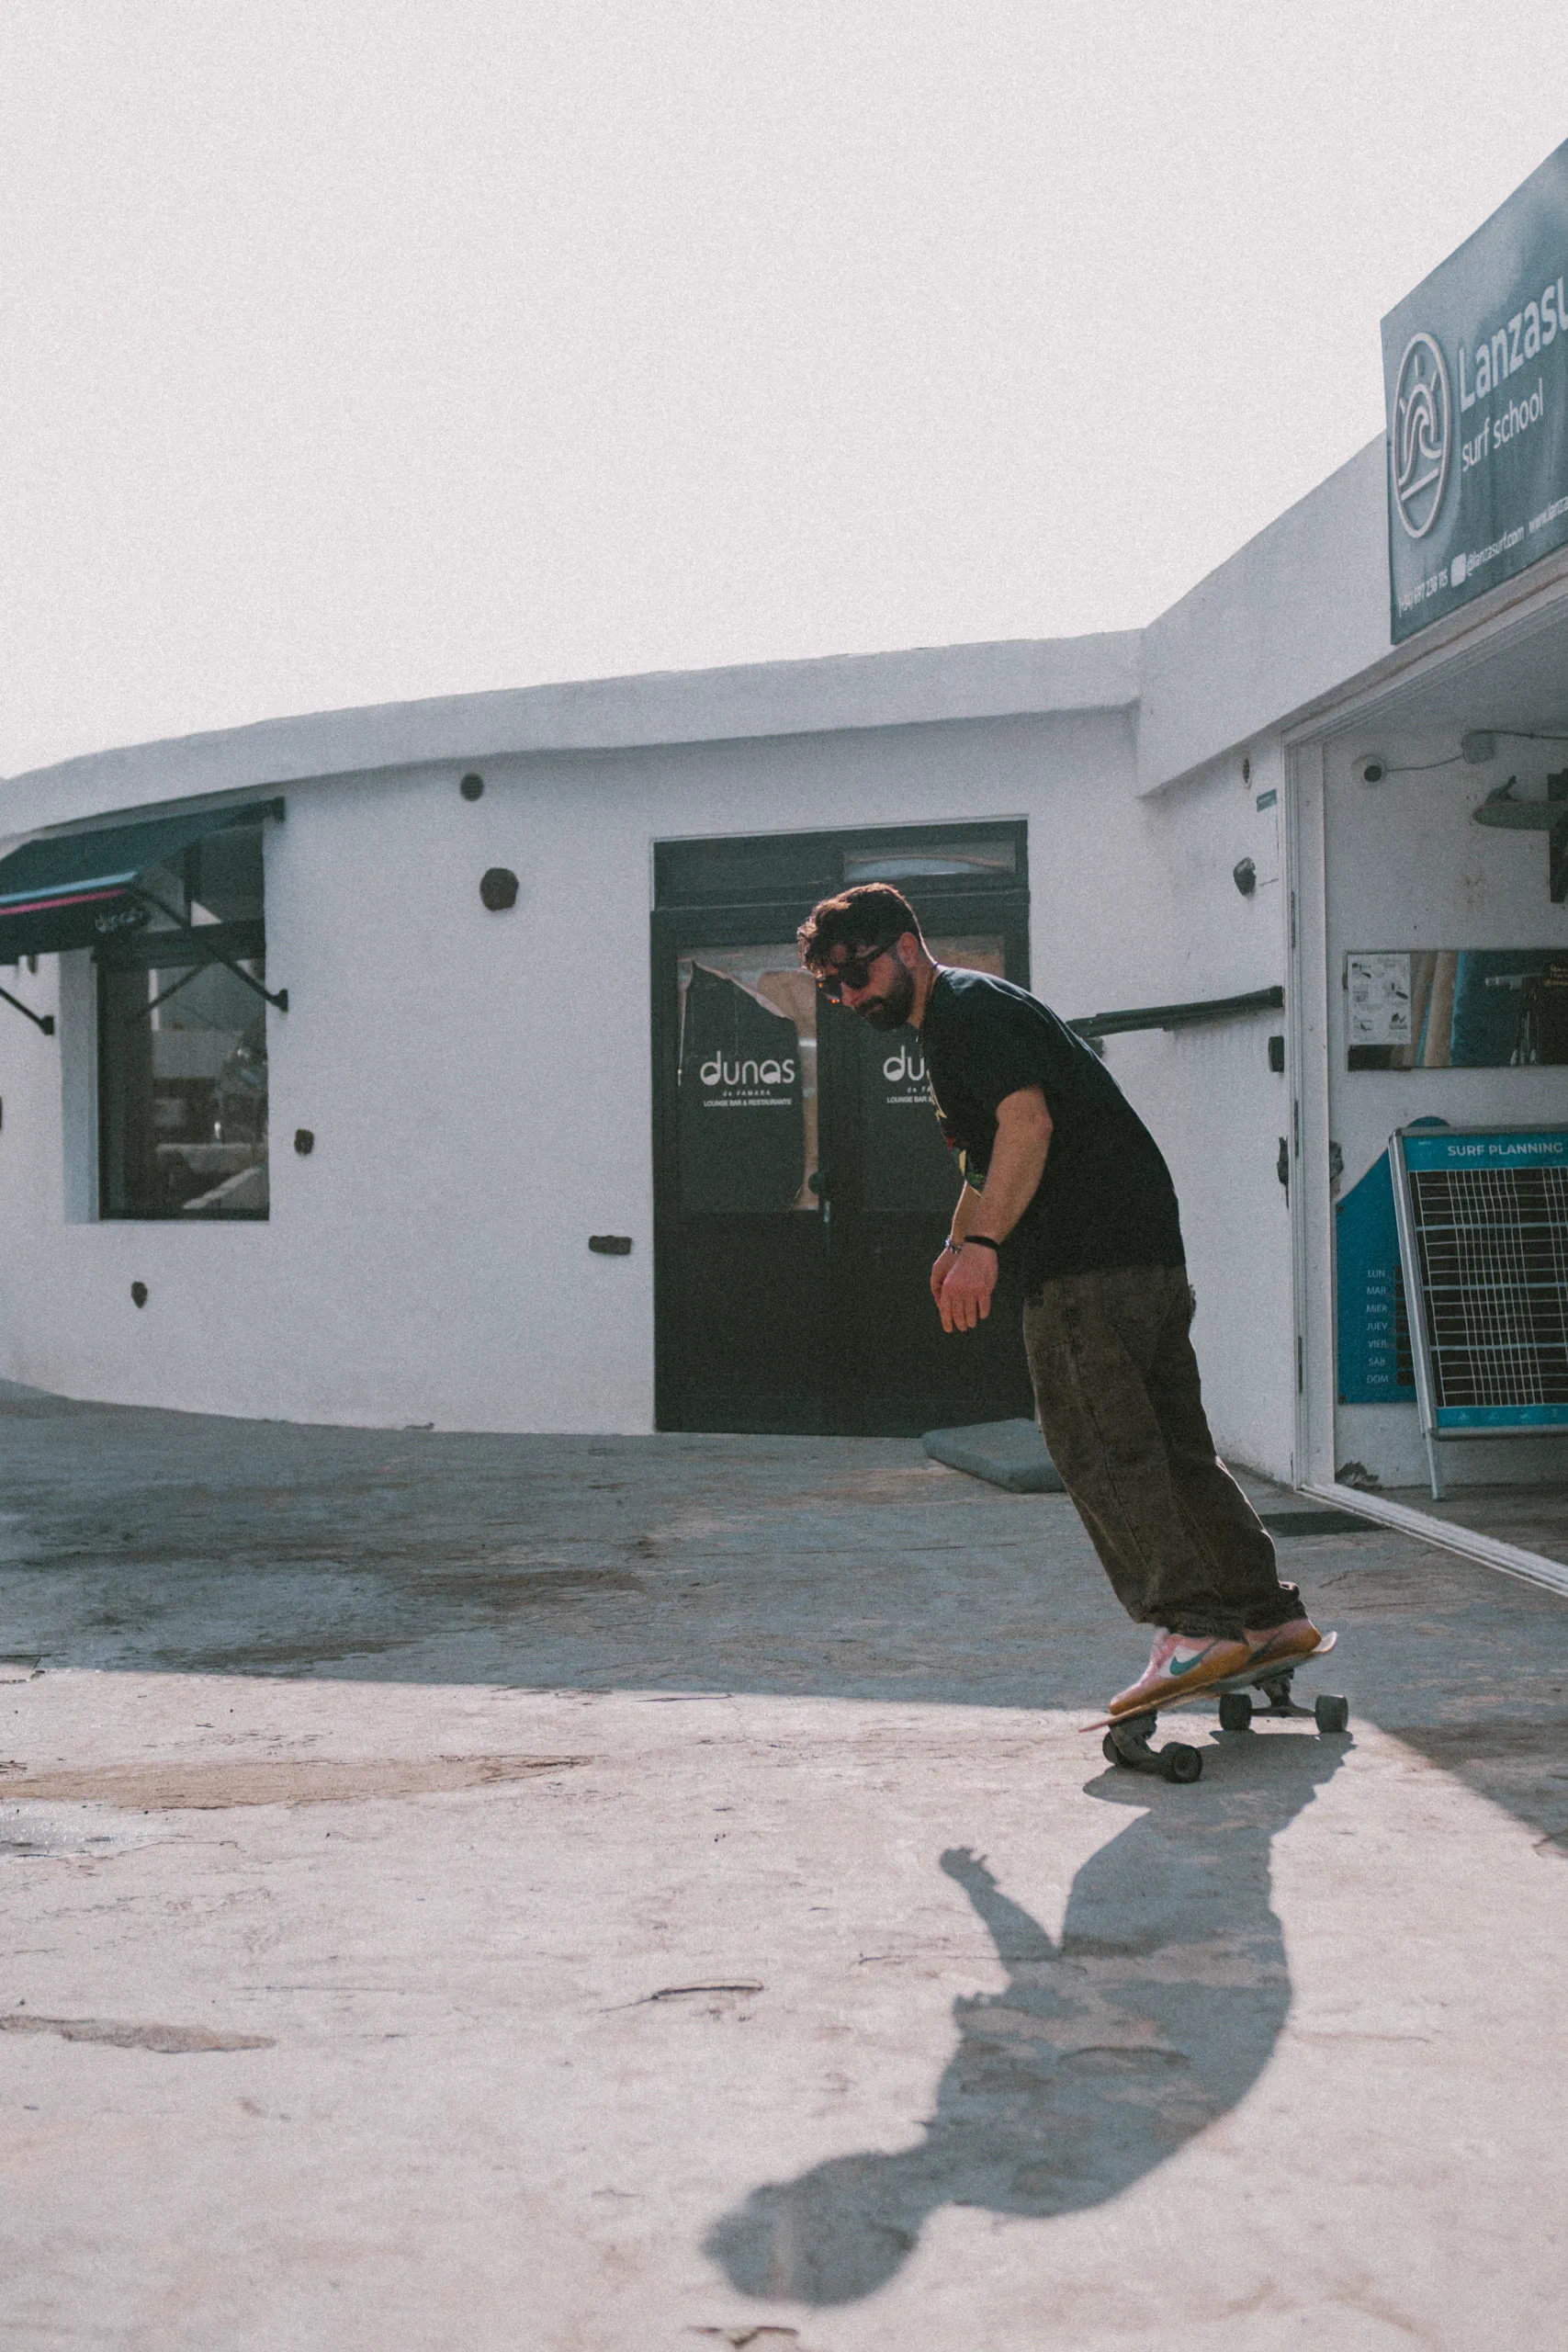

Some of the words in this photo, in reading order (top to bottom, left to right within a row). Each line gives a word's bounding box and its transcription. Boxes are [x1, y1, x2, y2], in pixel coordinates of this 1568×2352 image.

[1462, 416, 1490, 472] surf
[1493, 377, 1544, 449] school
[883, 1045, 930, 1081] du
[700, 1050, 795, 1086] dunas
[1448, 1144, 1484, 1157] SURF
[1488, 1142, 1563, 1155] PLANNING
[1367, 1269, 1385, 1278] LUN
[1366, 1286, 1386, 1295] MAR
[1366, 1304, 1388, 1313] MIER
[1366, 1322, 1388, 1331] JUEV
[1368, 1340, 1387, 1349] VIER
[1366, 1374, 1389, 1384] DOM
